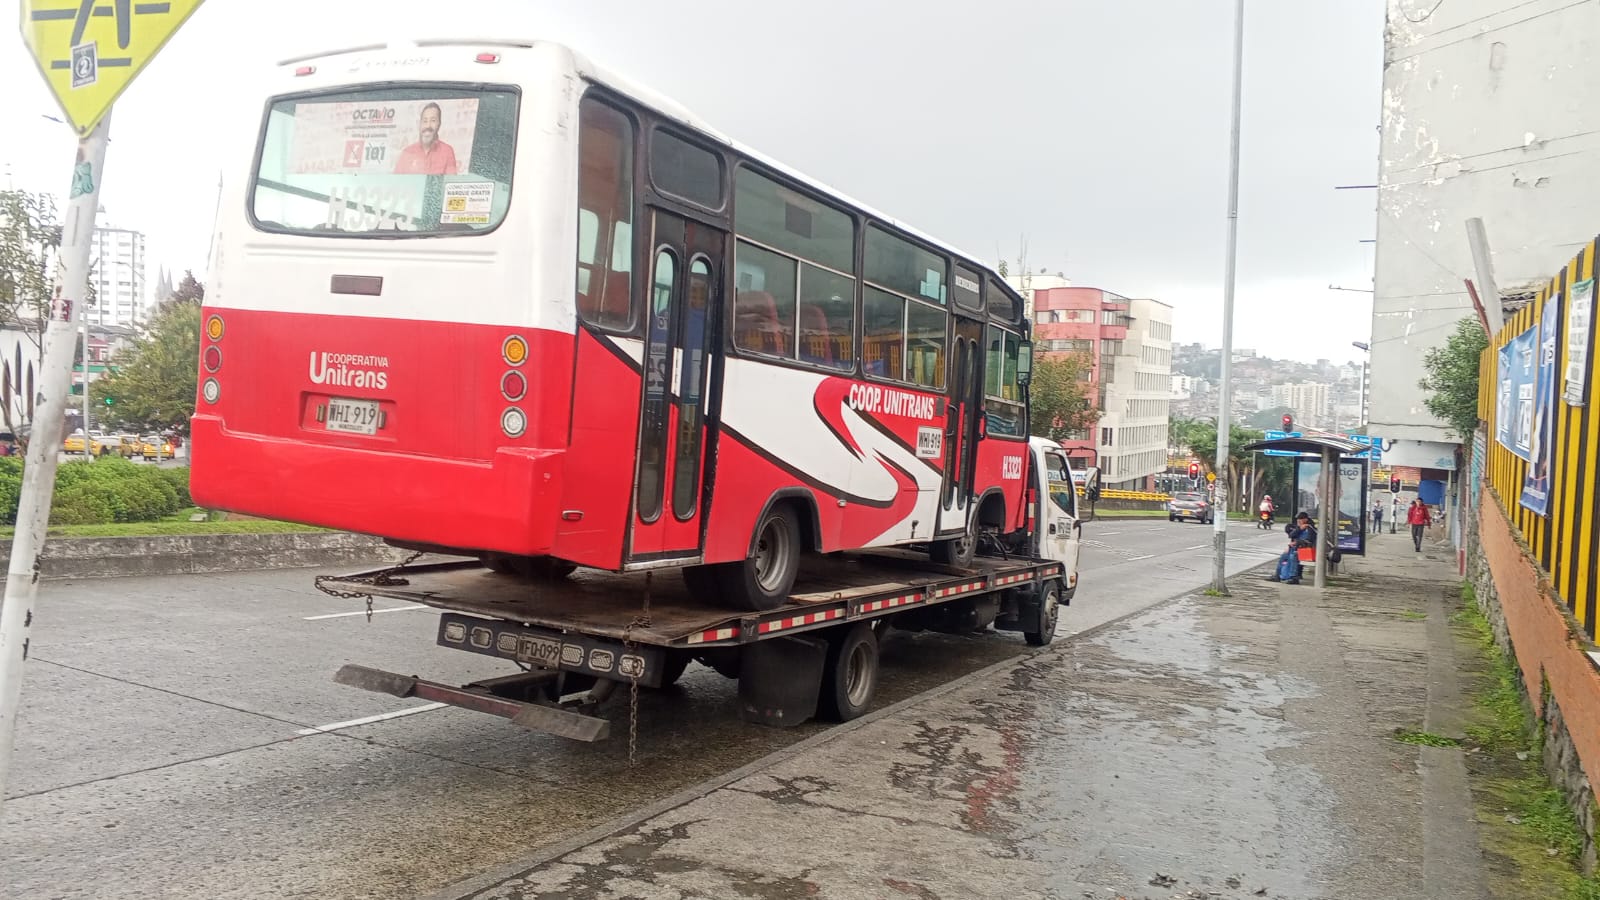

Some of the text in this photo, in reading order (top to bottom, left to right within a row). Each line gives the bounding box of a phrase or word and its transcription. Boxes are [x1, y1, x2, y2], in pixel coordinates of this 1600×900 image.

[352, 107, 396, 120] OCTAVIO
[309, 351, 388, 389] Unitrans
[327, 352, 389, 367] COOPERATIVA
[849, 384, 935, 420] COOP. UNITRANS
